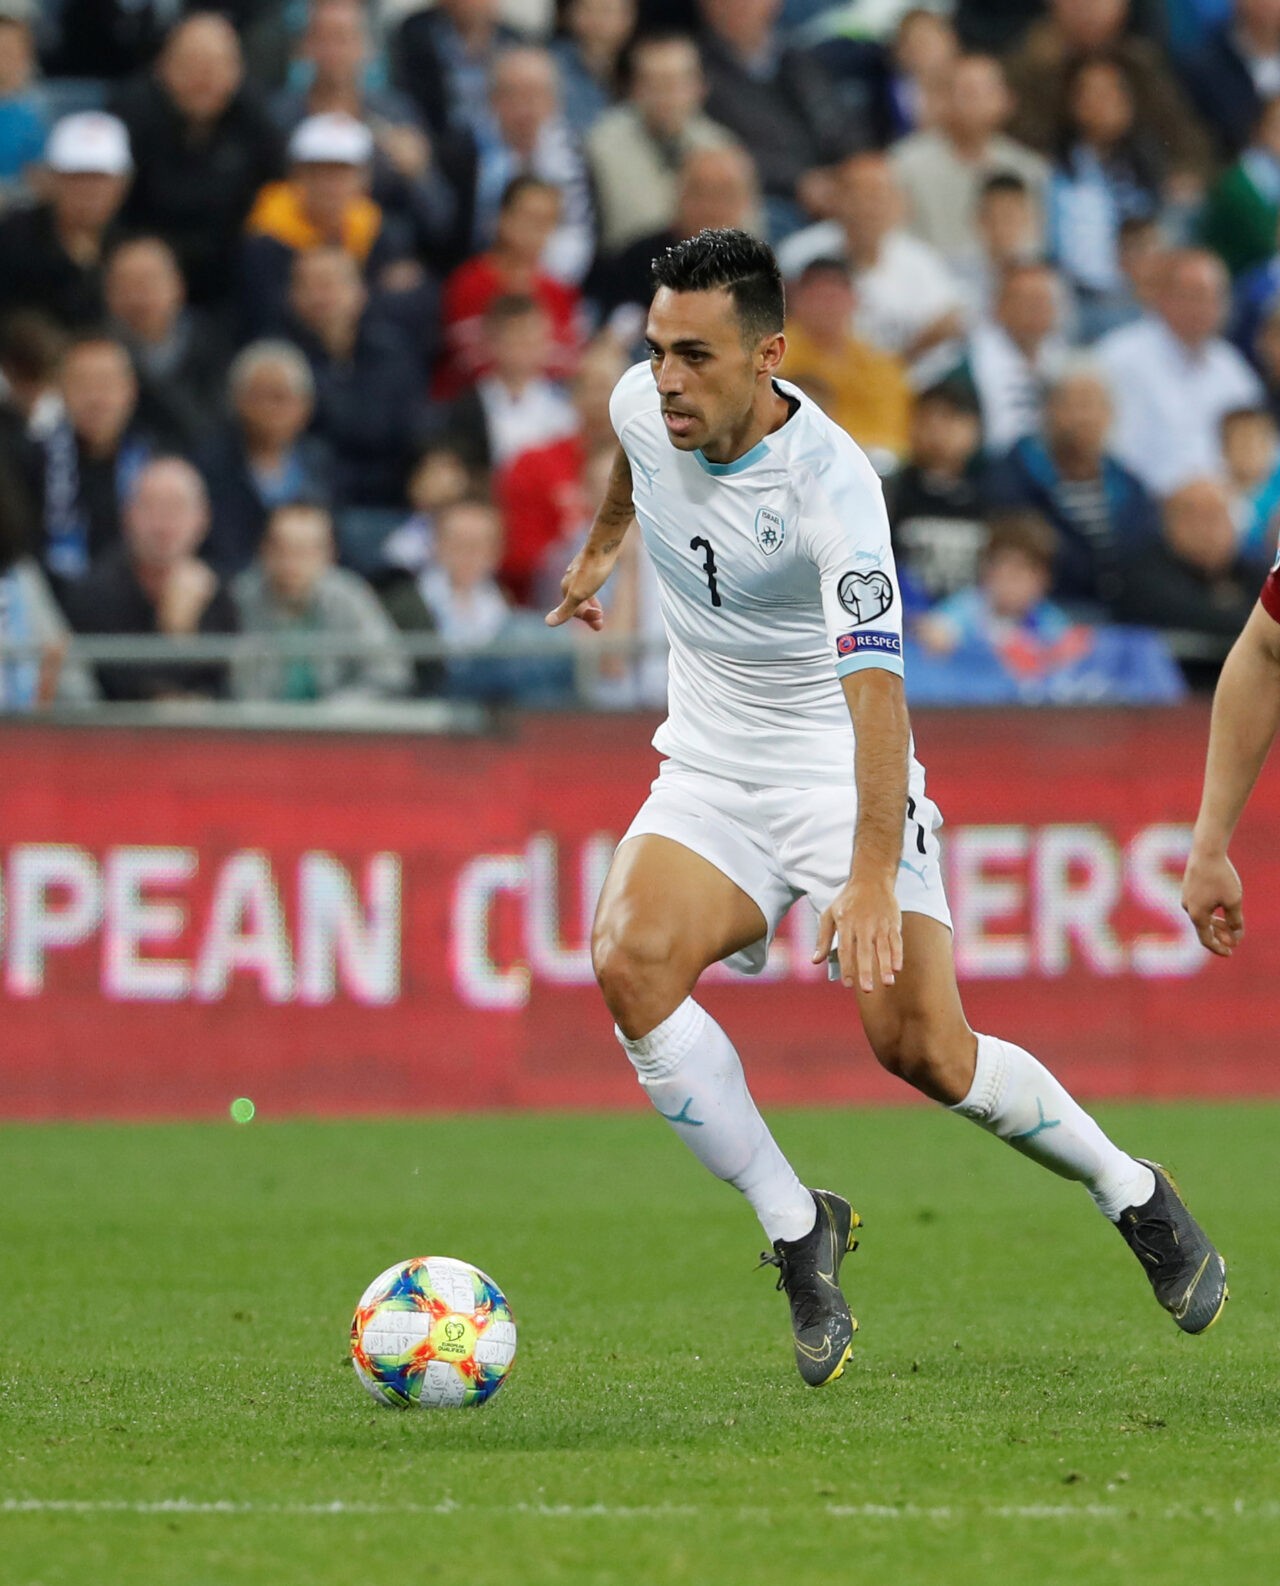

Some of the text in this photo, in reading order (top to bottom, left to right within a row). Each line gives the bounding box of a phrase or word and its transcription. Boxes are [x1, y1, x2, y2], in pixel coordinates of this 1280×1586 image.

[761, 510, 780, 525] ISRAEL
[690, 535, 722, 608] 7
[857, 635, 901, 650] RESPEC
[0, 842, 404, 1007] PEAN
